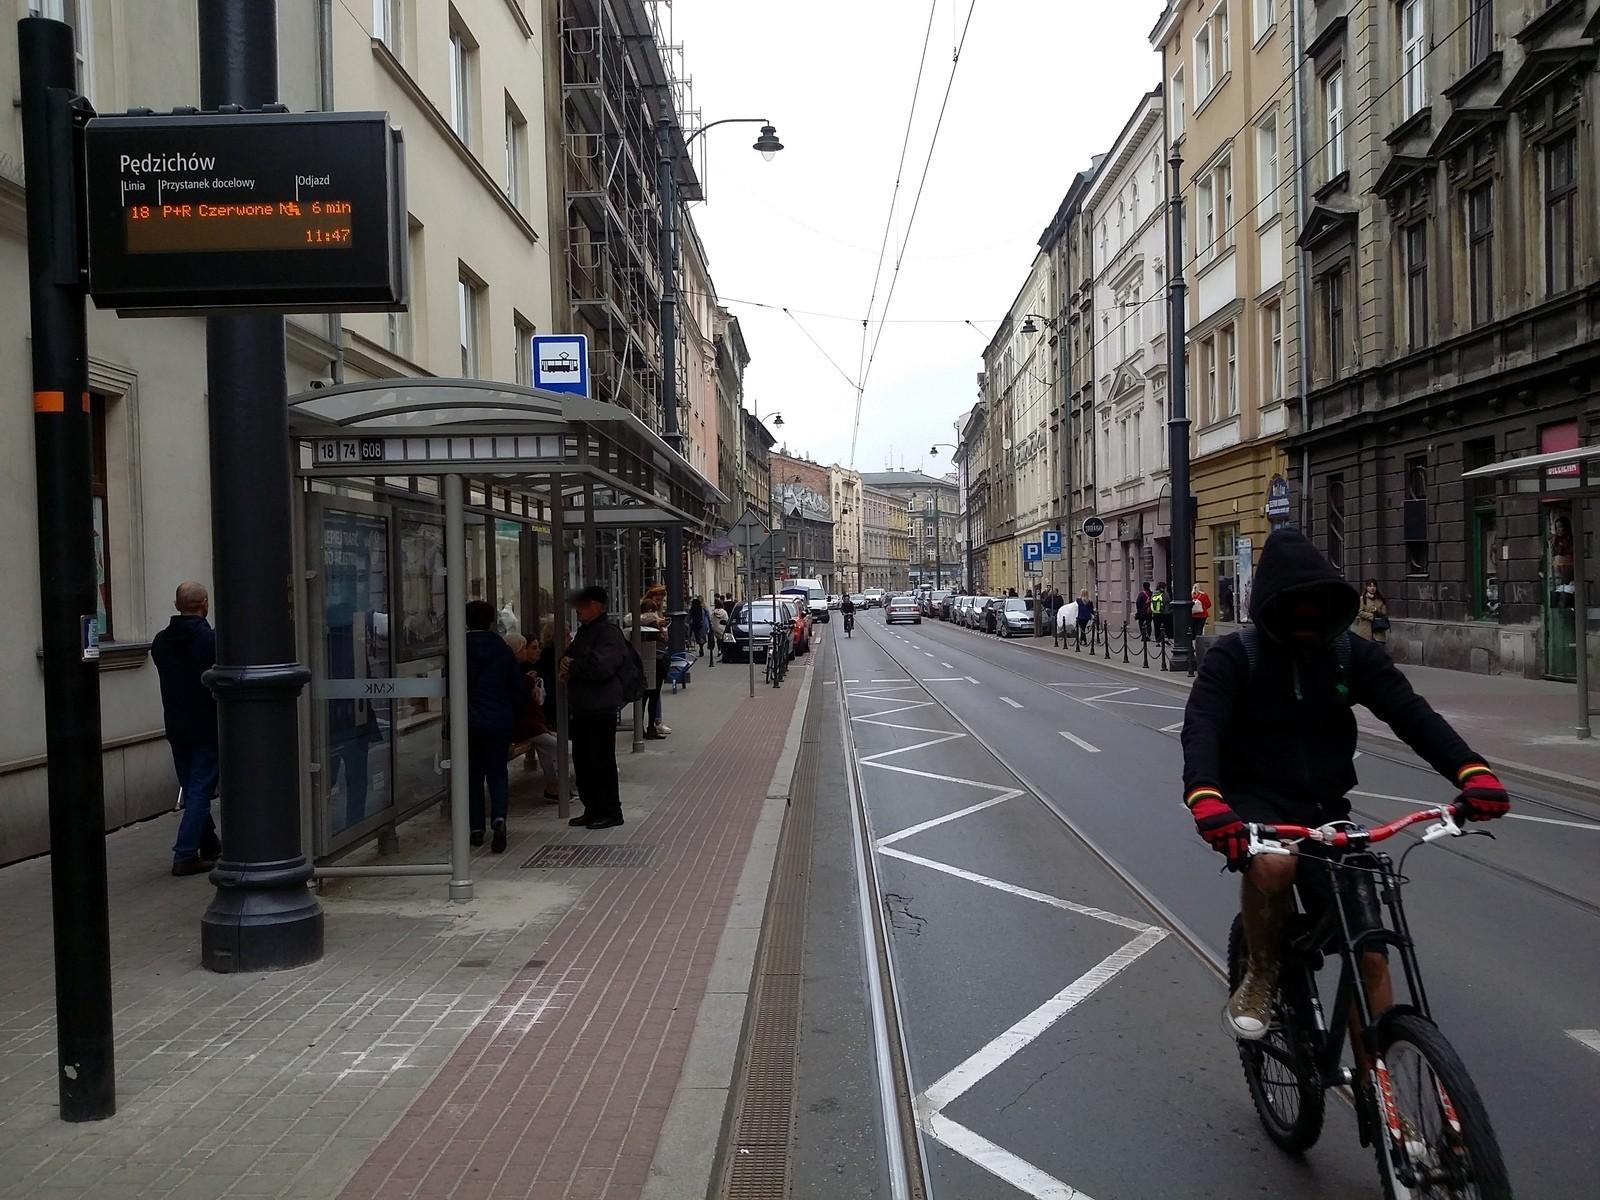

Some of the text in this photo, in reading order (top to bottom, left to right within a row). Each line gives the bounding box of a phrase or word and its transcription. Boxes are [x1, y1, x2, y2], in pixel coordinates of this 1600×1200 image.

[120, 152, 216, 175] Pędzichów
[123, 180, 146, 191] Linia
[161, 177, 255, 193] Przystanek docelowy
[298, 174, 331, 188] Odjazd
[130, 205, 150, 219] 18
[162, 204, 192, 218] P+R
[198, 203, 273, 217] Czerwone
[311, 201, 322, 214] 6
[326, 200, 351, 214] min
[305, 228, 351, 243] 11:47
[321, 442, 381, 459] 18 74 608
[1047, 533, 1058, 547] P
[1027, 544, 1038, 560] P
